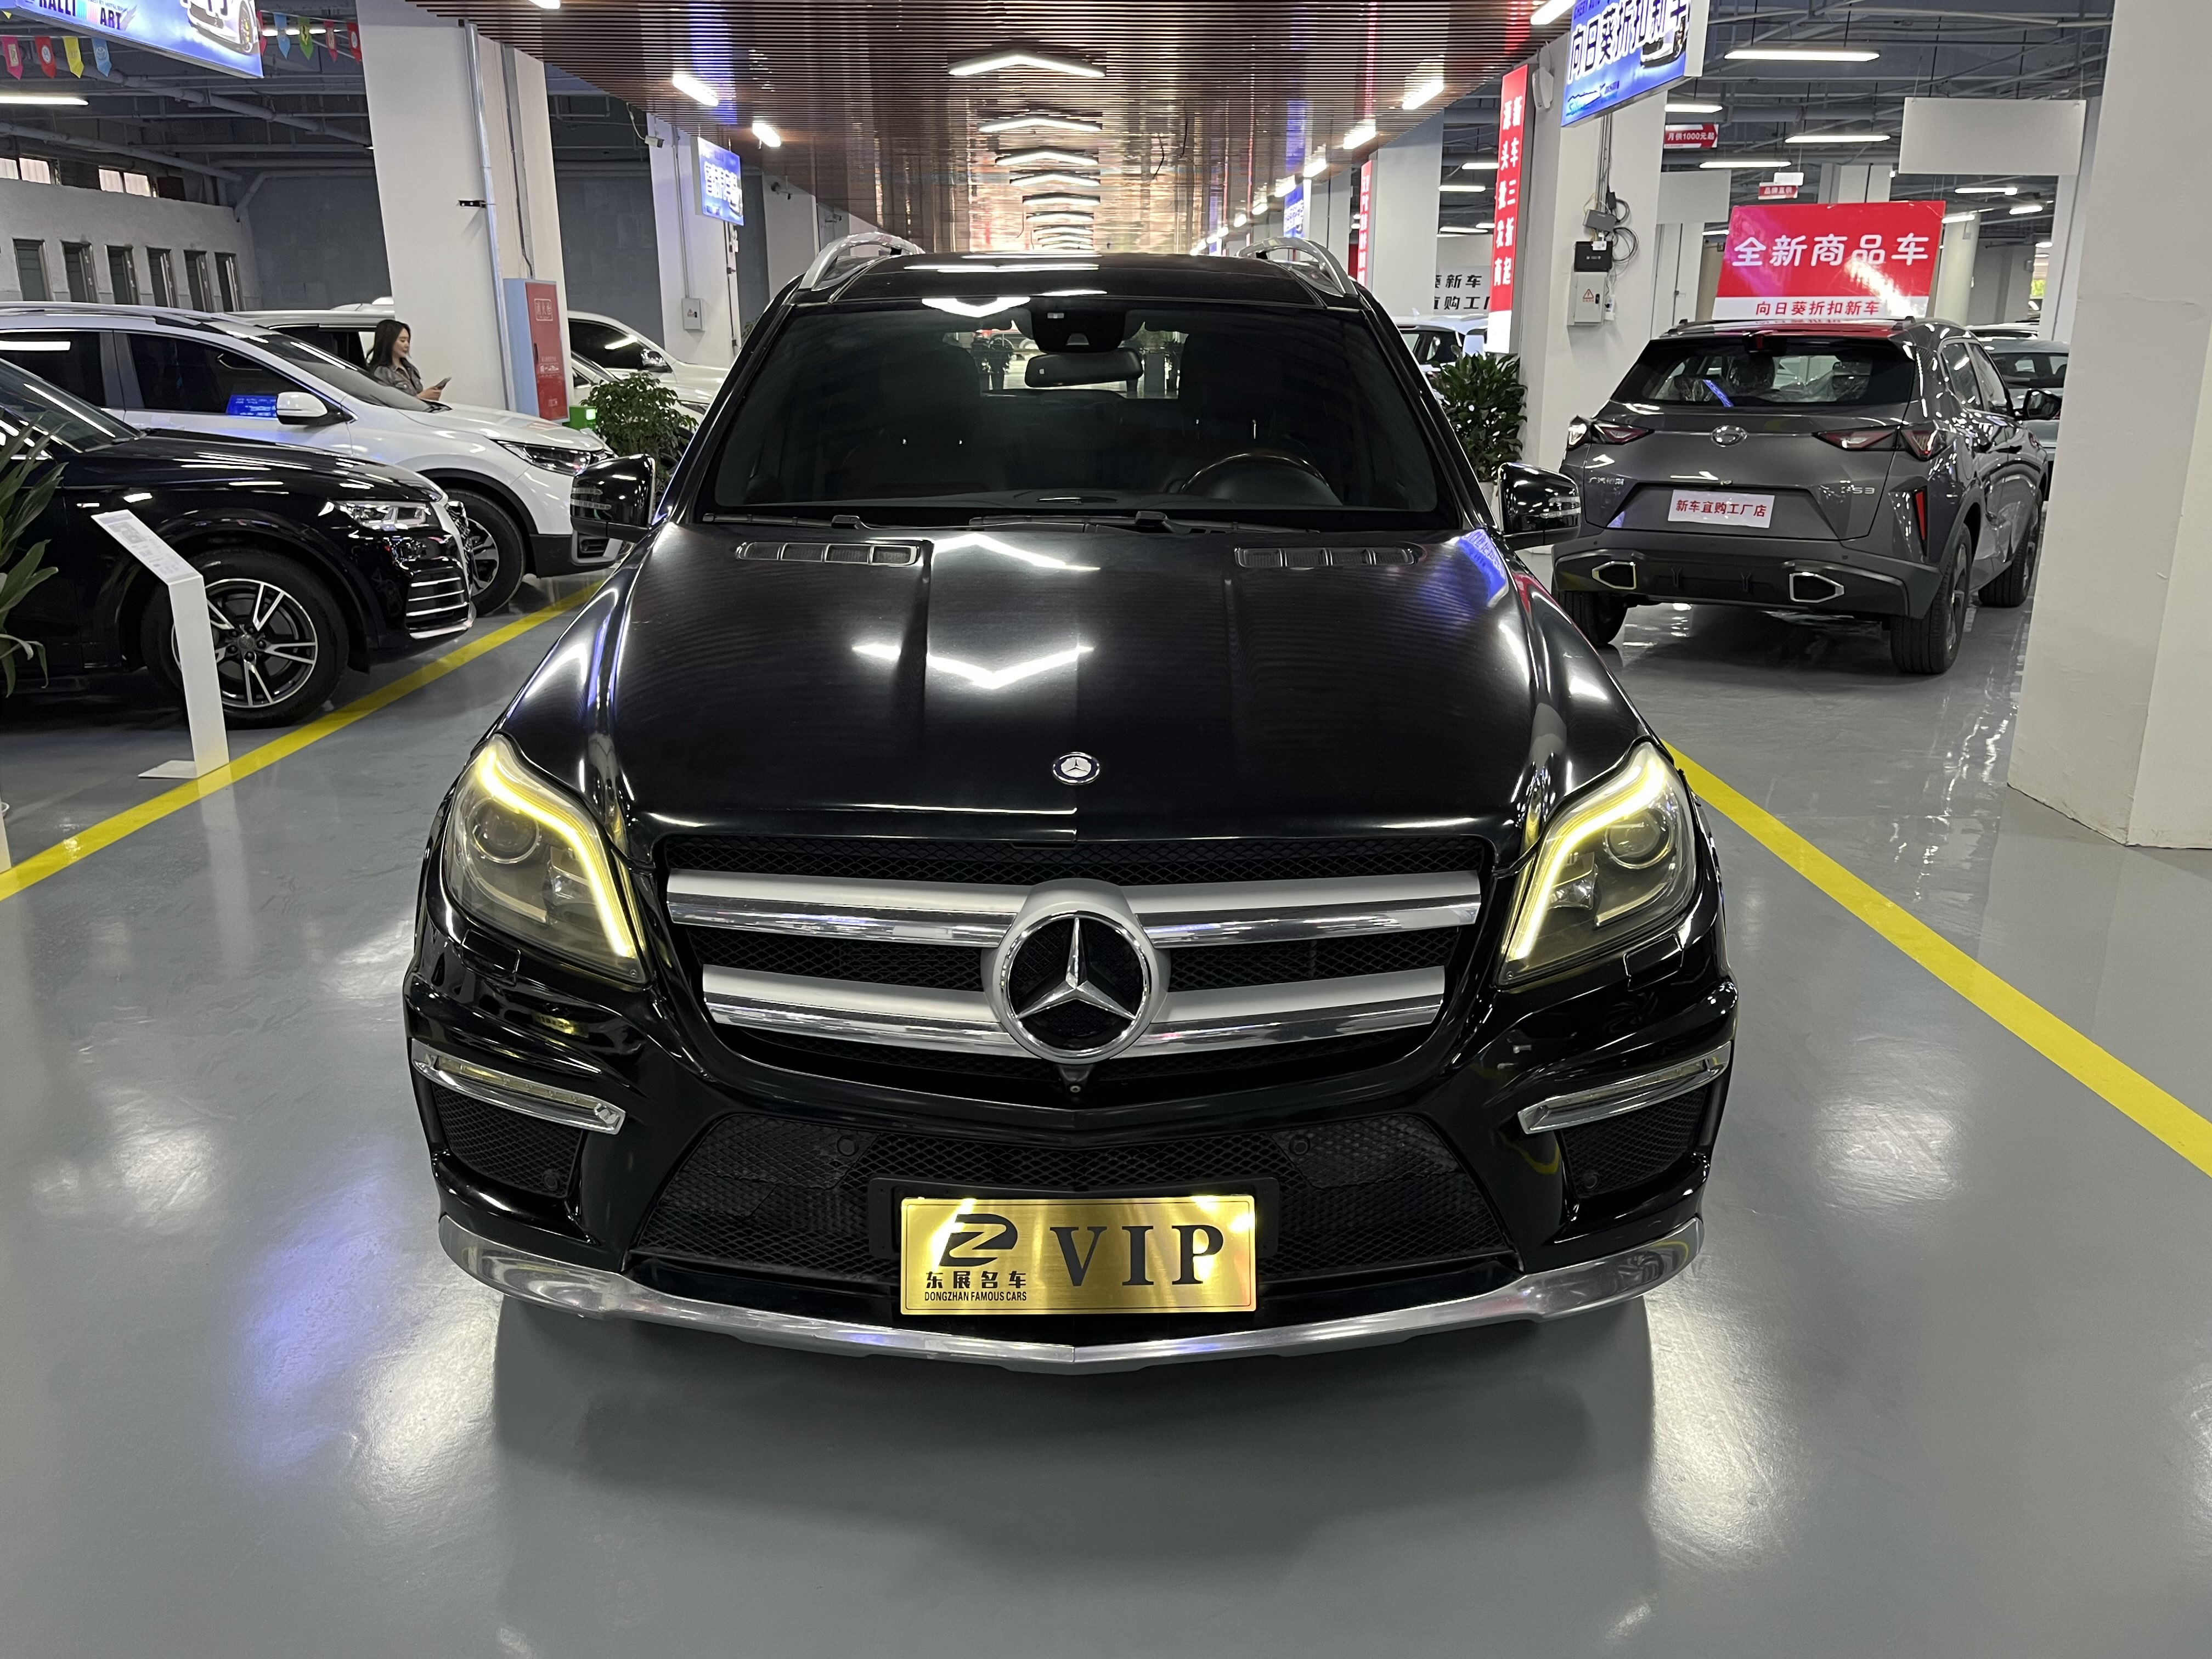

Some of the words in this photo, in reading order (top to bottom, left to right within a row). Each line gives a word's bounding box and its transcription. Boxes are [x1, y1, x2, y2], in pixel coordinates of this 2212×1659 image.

[100, 7, 122, 30] ART
[1732, 233, 1929, 267] 全新商品车
[1756, 300, 1880, 315] 向日葵折扣新车
[1676, 500, 1767, 518] 新车直购工厂店
[1049, 1224, 1224, 1286] VIP
[926, 1271, 1026, 1289] 东展名车
[924, 1291, 969, 1301] DONGZHAN
[970, 1291, 1005, 1301] FAMOUS
[1006, 1291, 1027, 1301] CARS
